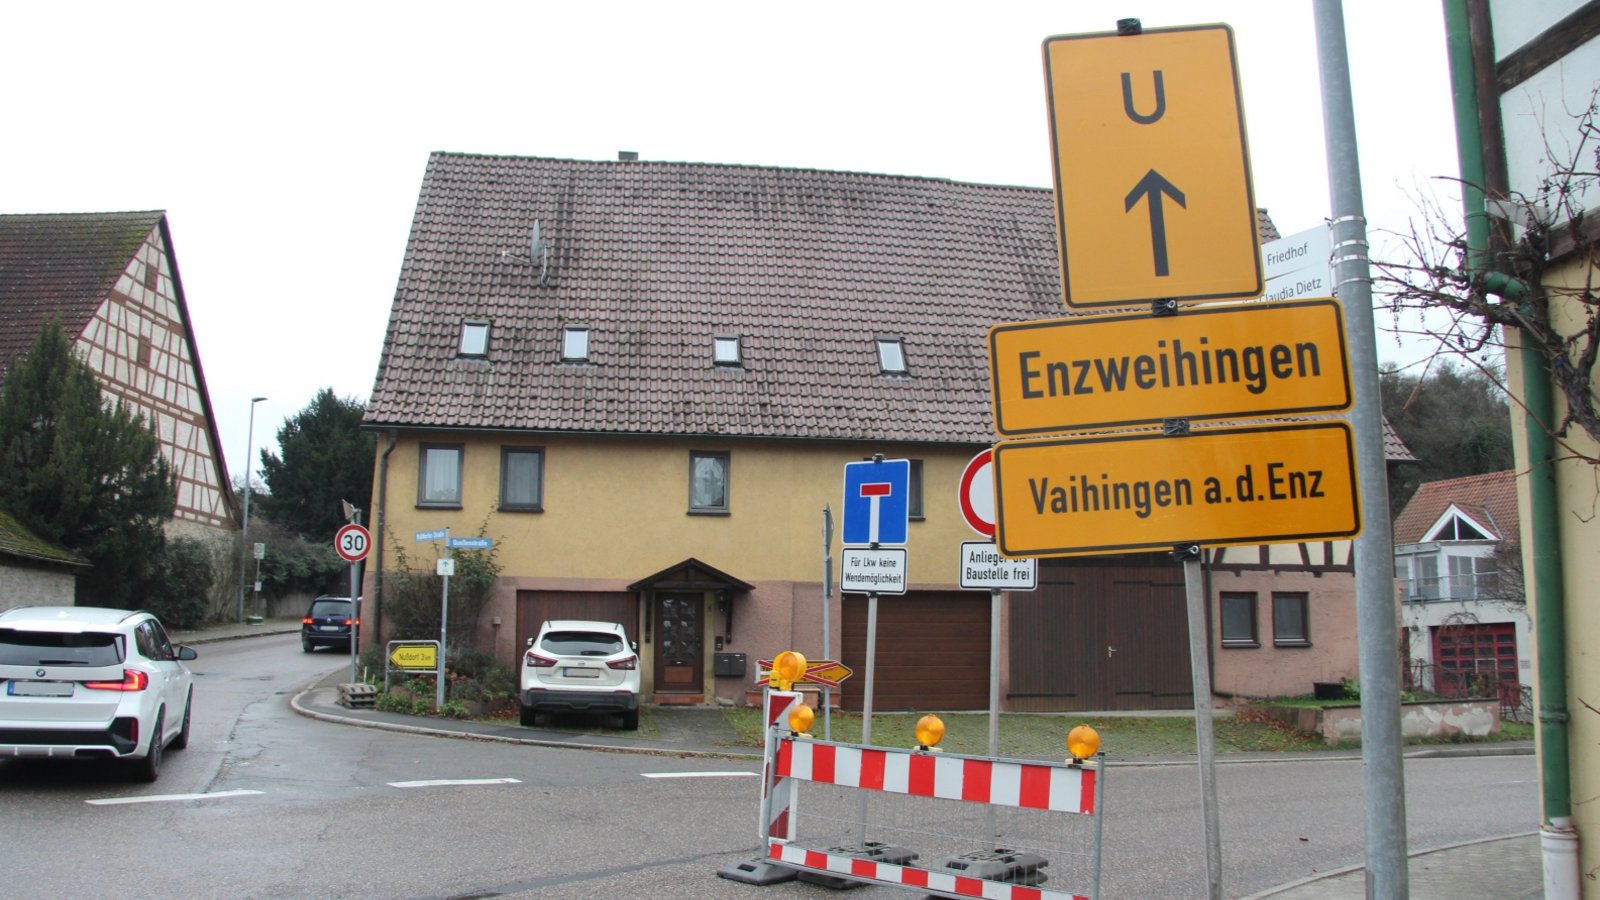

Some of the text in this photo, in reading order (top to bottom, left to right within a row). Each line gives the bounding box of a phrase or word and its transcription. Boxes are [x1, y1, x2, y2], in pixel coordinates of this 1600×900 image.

[1121, 70, 1166, 124] U
[1266, 243, 1308, 266] Friedhof
[1259, 278, 1322, 303] laudia Dietz
[1019, 337, 1320, 399] Enzweihingen
[1028, 462, 1325, 518] Vaihingen a.d.Enz
[343, 534, 364, 551] 30
[851, 556, 896, 568] Für Lkw keine
[845, 572, 902, 585] Wendemöglichkeit
[966, 567, 1030, 580] Baustelle frei
[399, 652, 420, 661] Nußdorf
